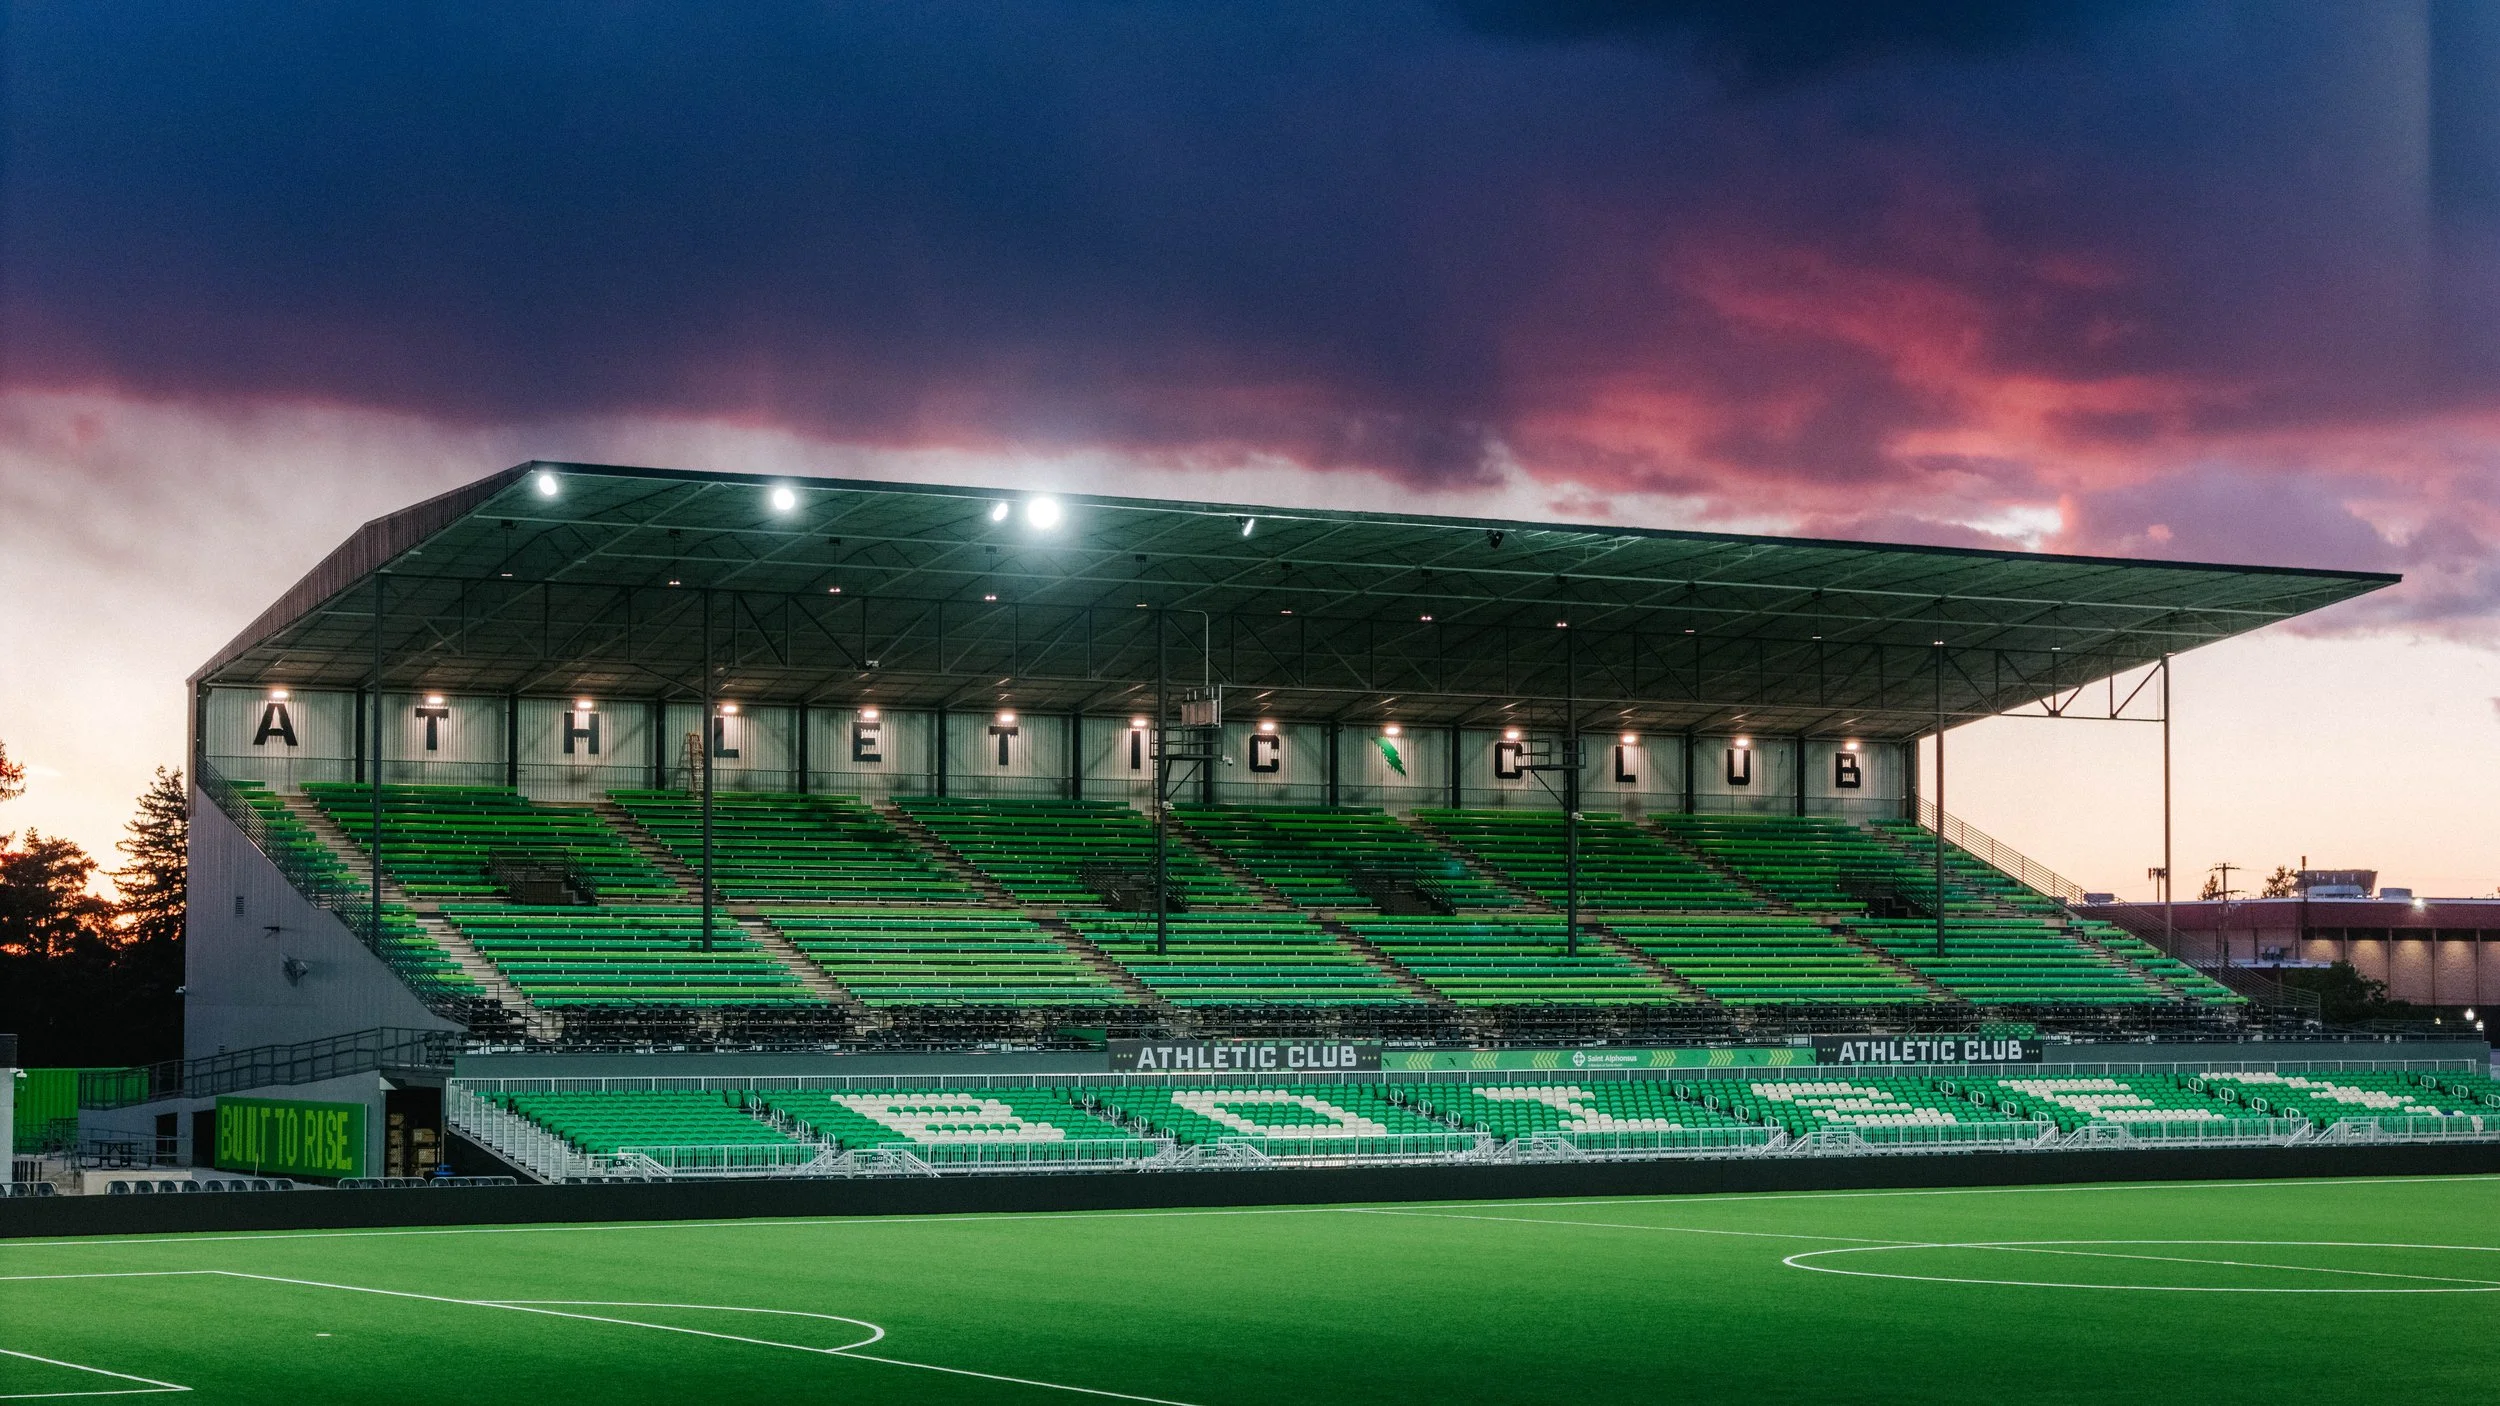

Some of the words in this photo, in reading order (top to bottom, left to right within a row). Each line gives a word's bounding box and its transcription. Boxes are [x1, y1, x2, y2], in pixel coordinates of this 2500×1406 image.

[253, 701, 1280, 773] ATHLETIC
[1495, 740, 1861, 789] CLUB
[1137, 1046, 1277, 1069] ATHLETIC
[1287, 1045, 1357, 1068] CLUB
[1604, 1055, 1638, 1063] Alphonsus
[1838, 1041, 1955, 1062] ATHLETIC
[1964, 1039, 2022, 1060] CLUB
[220, 1104, 271, 1164] BUILT
[275, 1107, 298, 1167] TO
